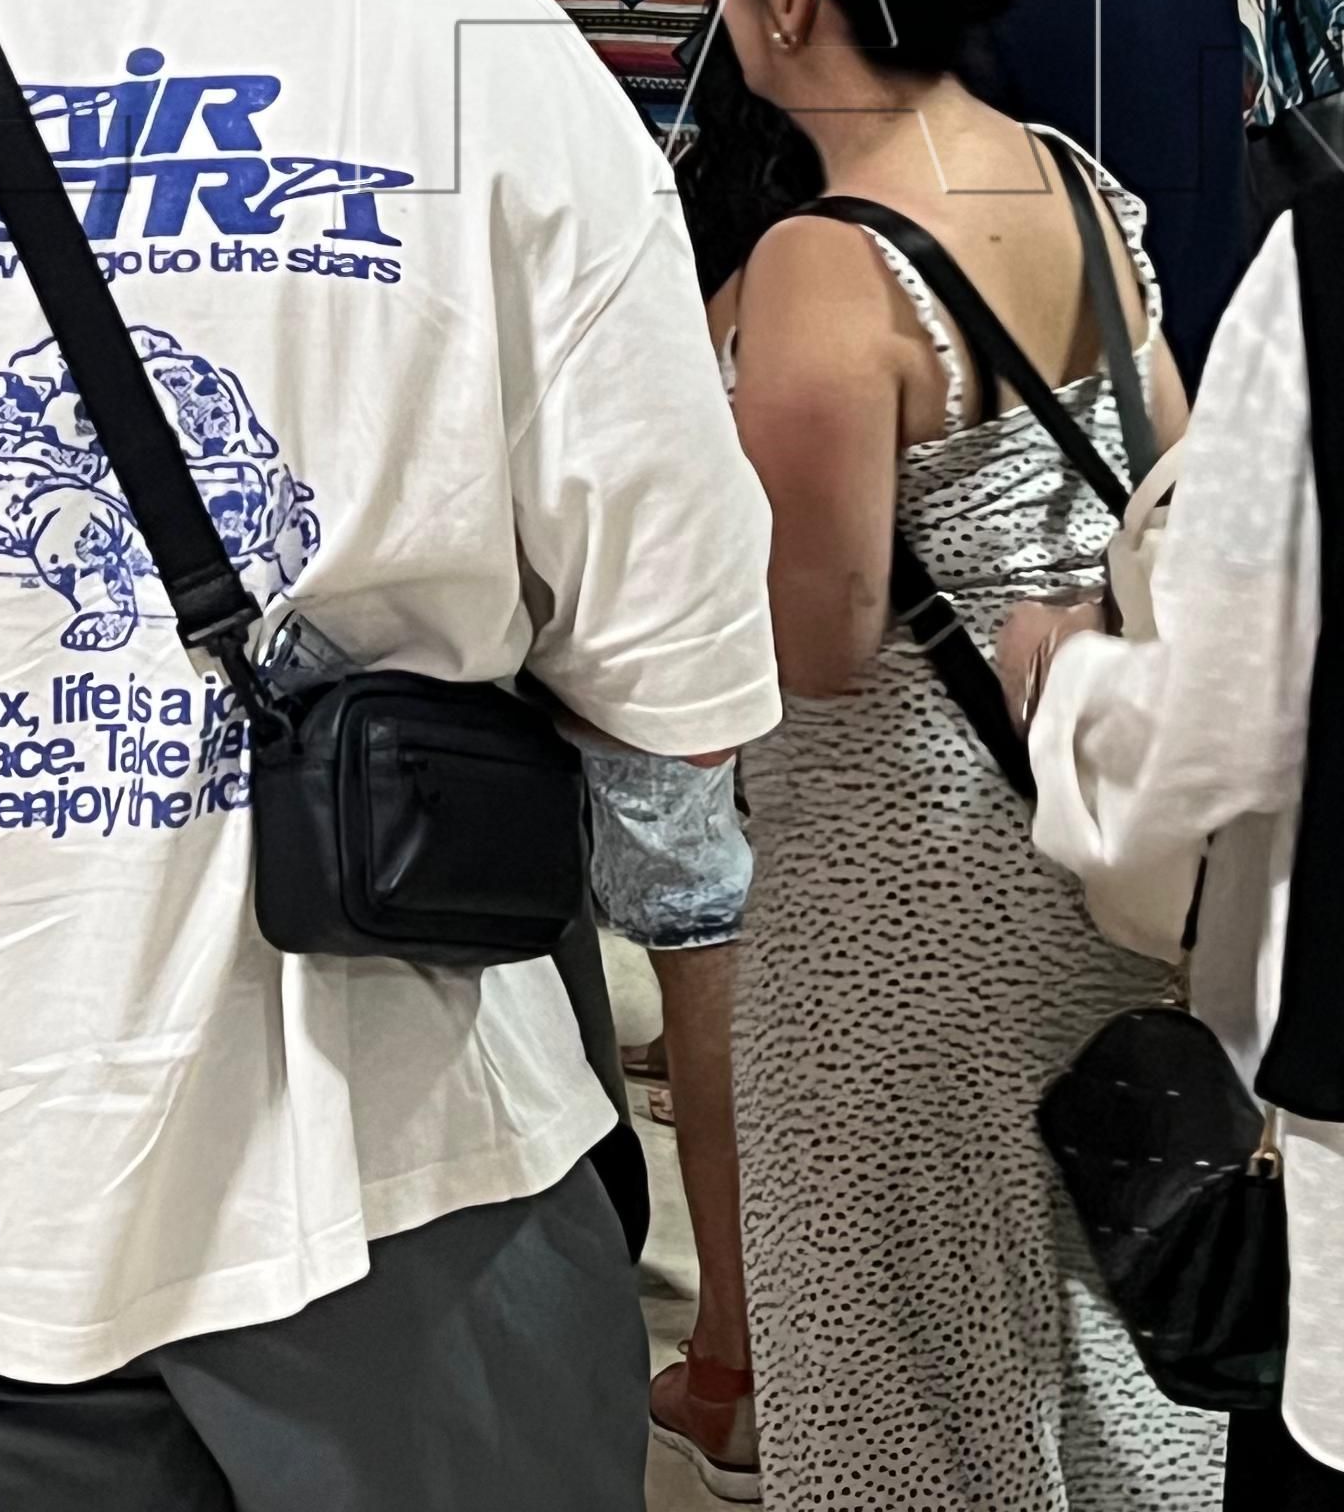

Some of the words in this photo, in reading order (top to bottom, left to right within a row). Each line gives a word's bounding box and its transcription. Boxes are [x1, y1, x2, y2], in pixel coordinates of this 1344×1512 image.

[93, 250, 143, 287] go
[149, 243, 201, 275] to
[210, 239, 279, 273] the
[285, 242, 402, 284] stars
[52, 671, 121, 725] life
[127, 671, 152, 724] is
[159, 688, 192, 726] a
[95, 723, 190, 778] Take
[127, 776, 193, 829] the
